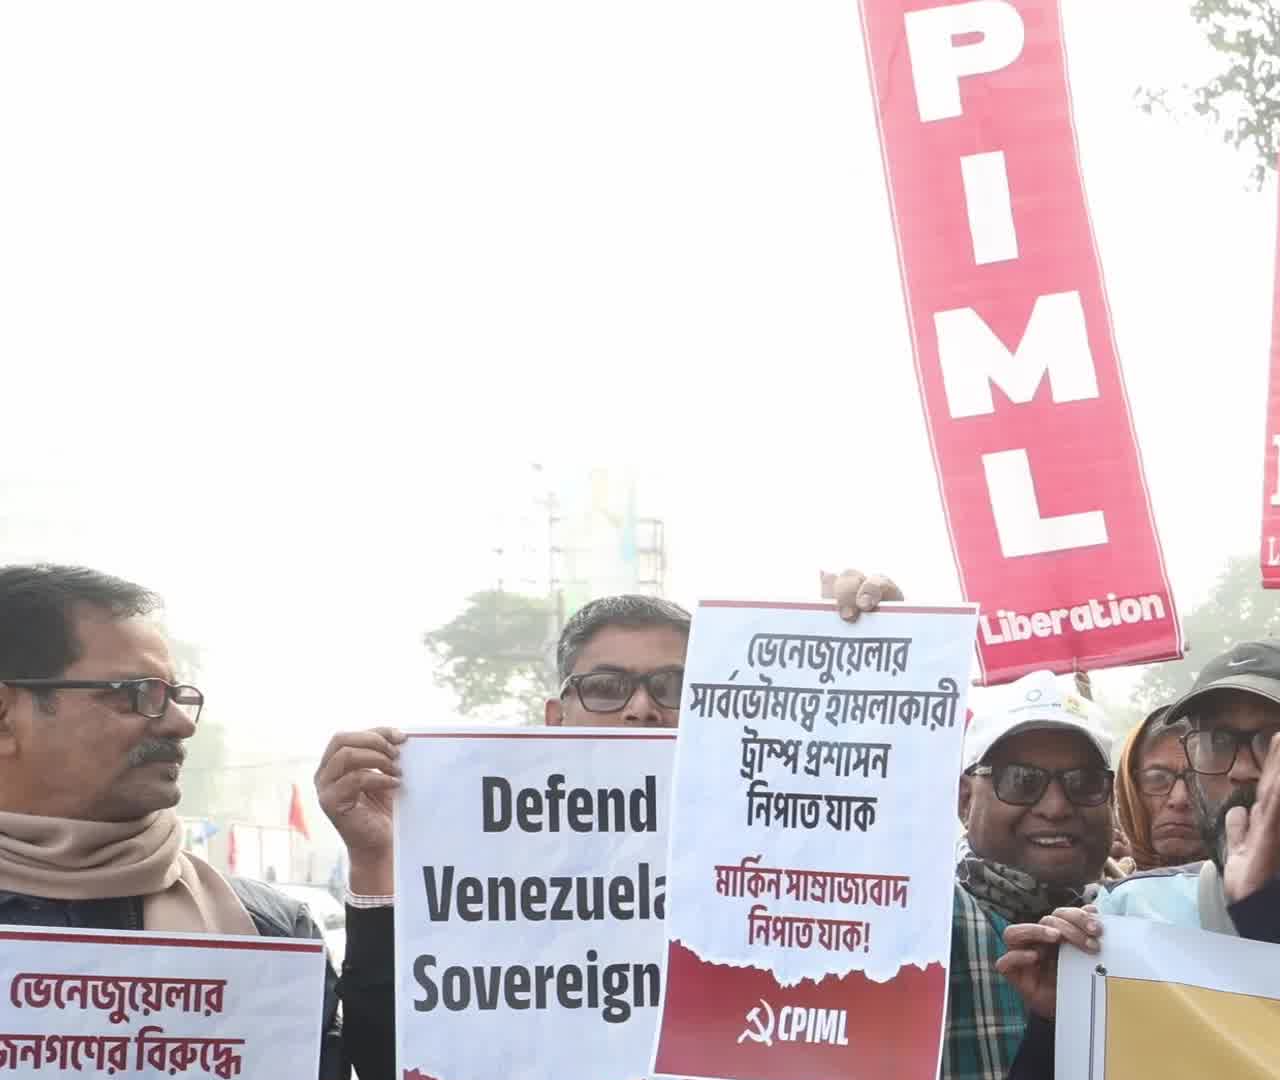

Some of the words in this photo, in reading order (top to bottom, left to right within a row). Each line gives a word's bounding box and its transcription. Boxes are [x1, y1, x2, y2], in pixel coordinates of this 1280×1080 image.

[980, 592, 1166, 645] Liberation
[748, 633, 912, 684] ভেনেজুয়েলার
[689, 670, 822, 732] সার্বভৌমত্বে
[824, 678, 960, 730] হামলাকারী
[740, 727, 801, 780] ট্রাম্প
[804, 739, 891, 779] প্রশাসন
[482, 774, 657, 833] Defend
[747, 781, 821, 830] নিপাত
[826, 795, 877, 832] যাক
[714, 855, 784, 899] মার্কিন
[785, 870, 910, 908] সাম্রাজ্যবাদ
[748, 905, 814, 949] নিপাত
[816, 920, 870, 953] যাক!
[10, 973, 227, 1024] ভেনেজুয়েলার
[136, 1026, 245, 1079] বিরুদ্ধে
[778, 1006, 849, 1046] CPIML
